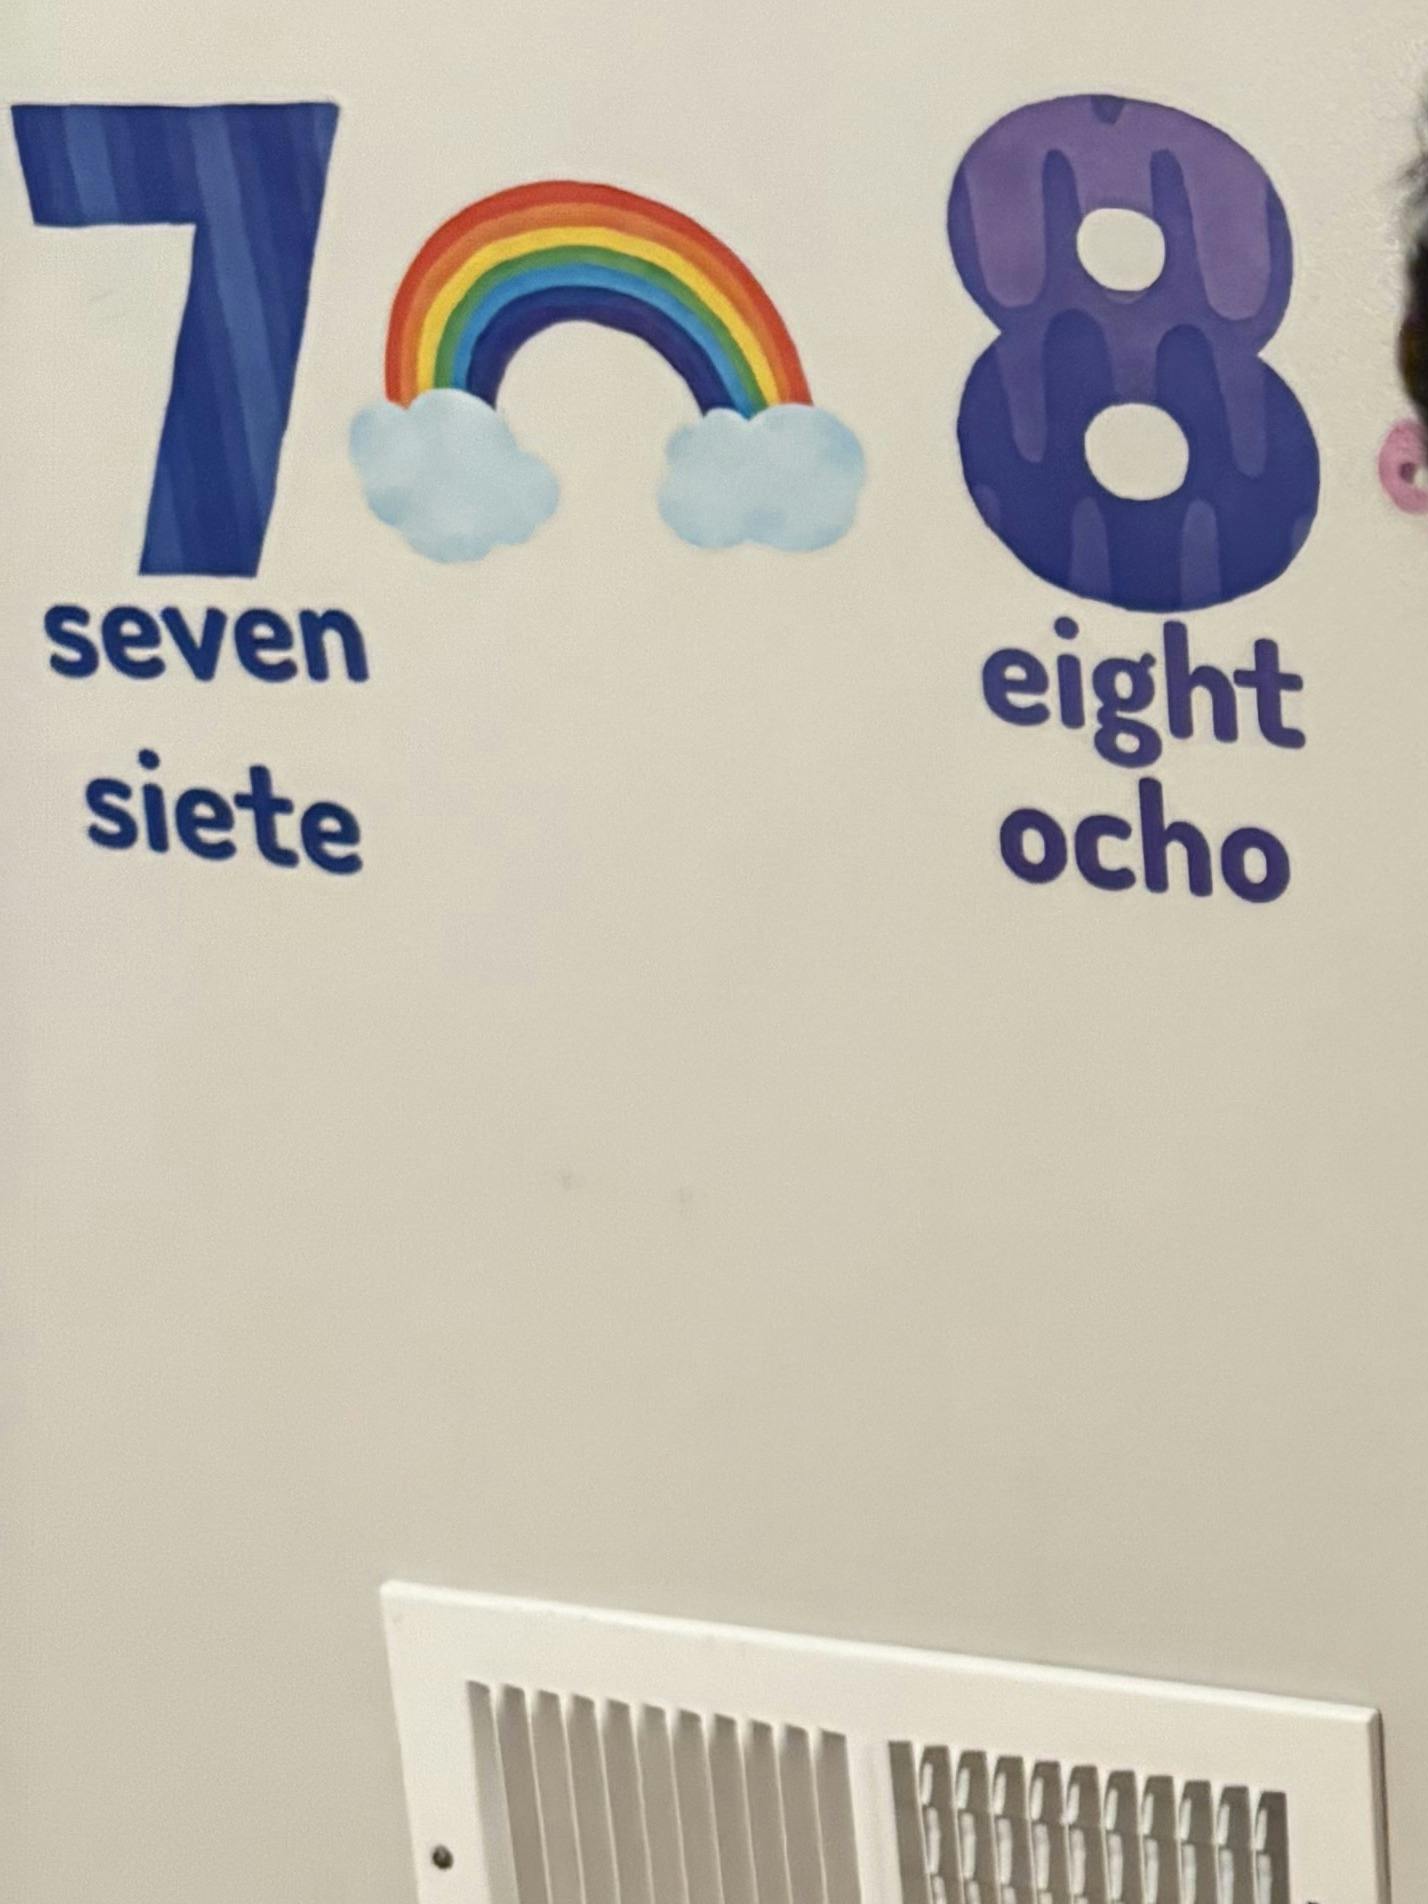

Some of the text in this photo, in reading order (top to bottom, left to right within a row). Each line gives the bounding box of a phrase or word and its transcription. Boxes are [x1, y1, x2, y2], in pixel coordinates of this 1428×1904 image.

[10, 99, 341, 578] 7
[947, 94, 1321, 613] 8
[43, 604, 369, 683] seven
[981, 615, 1306, 769] eight
[84, 748, 363, 875] siete
[1000, 777, 1290, 902] ocho
